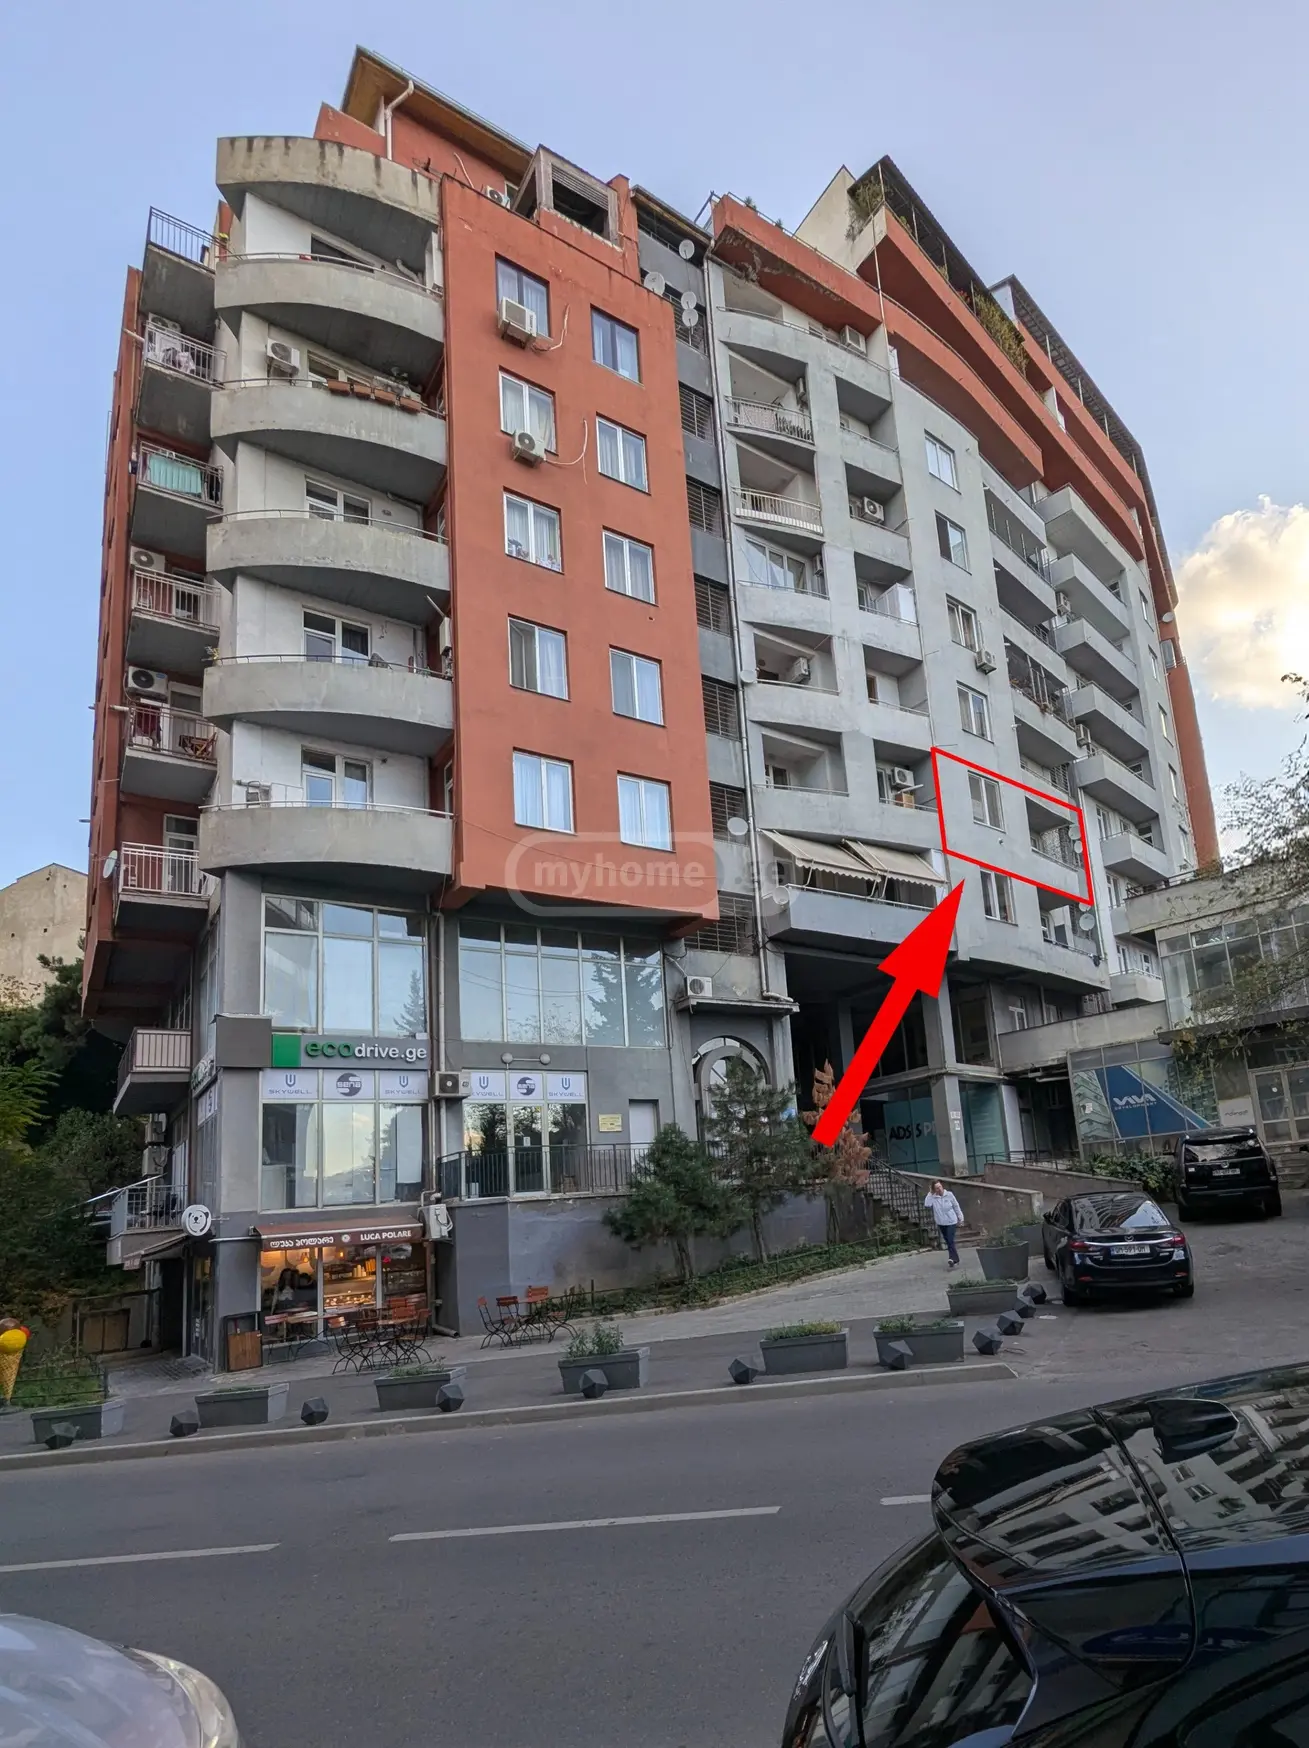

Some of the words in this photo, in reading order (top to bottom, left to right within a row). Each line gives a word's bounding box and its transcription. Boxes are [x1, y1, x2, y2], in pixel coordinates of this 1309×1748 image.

[306, 1041, 427, 1063] ecodrive.ge
[1113, 1093, 1157, 1106] VIVA
[360, 1232, 381, 1241] LUCA
[382, 1230, 412, 1239] POLARE
